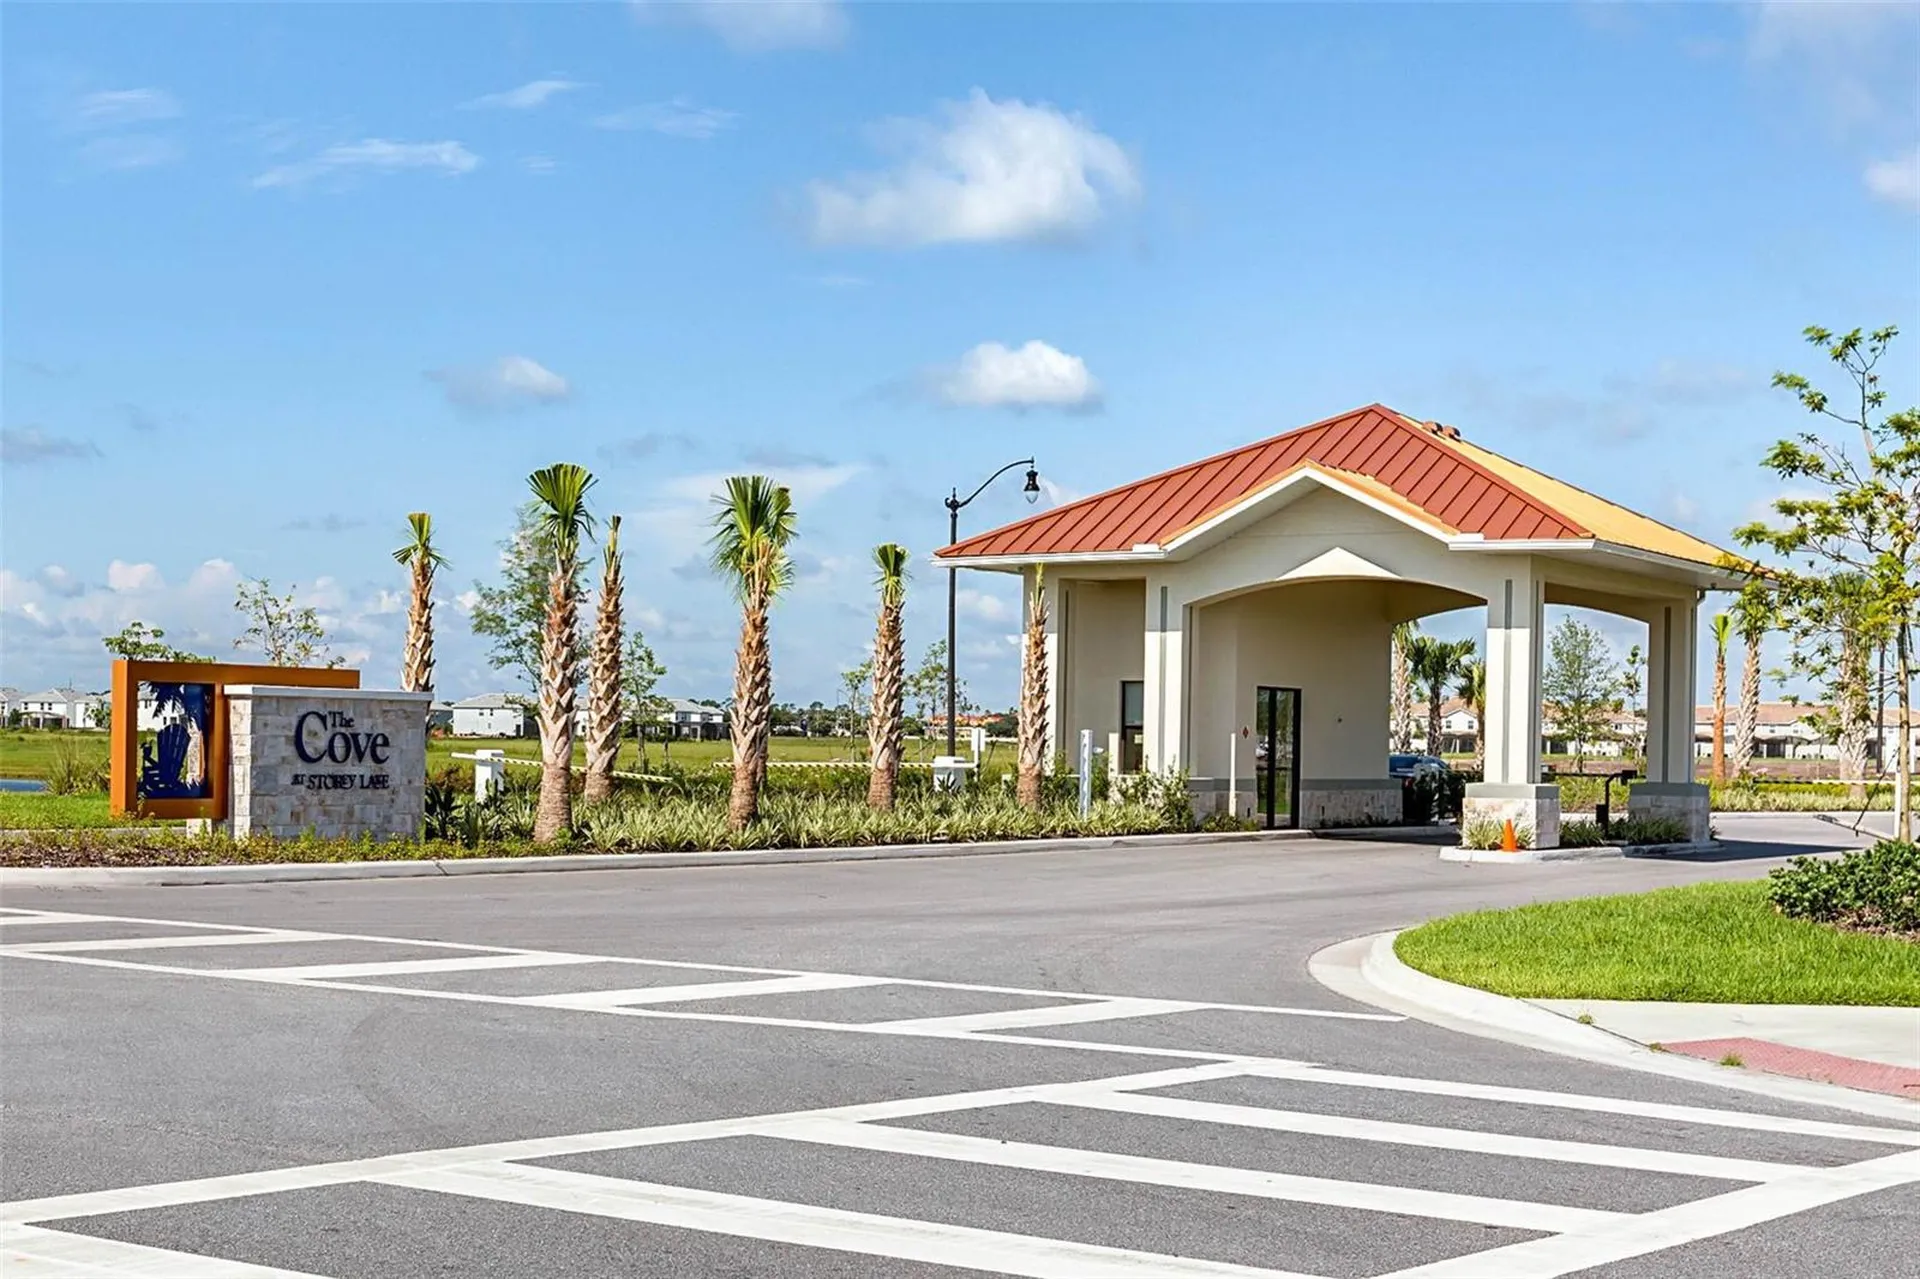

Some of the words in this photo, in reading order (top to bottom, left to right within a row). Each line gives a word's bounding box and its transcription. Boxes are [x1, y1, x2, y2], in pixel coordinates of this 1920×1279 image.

[328, 711, 355, 728] The
[294, 711, 390, 764] Cove
[306, 773, 357, 790] STOREY
